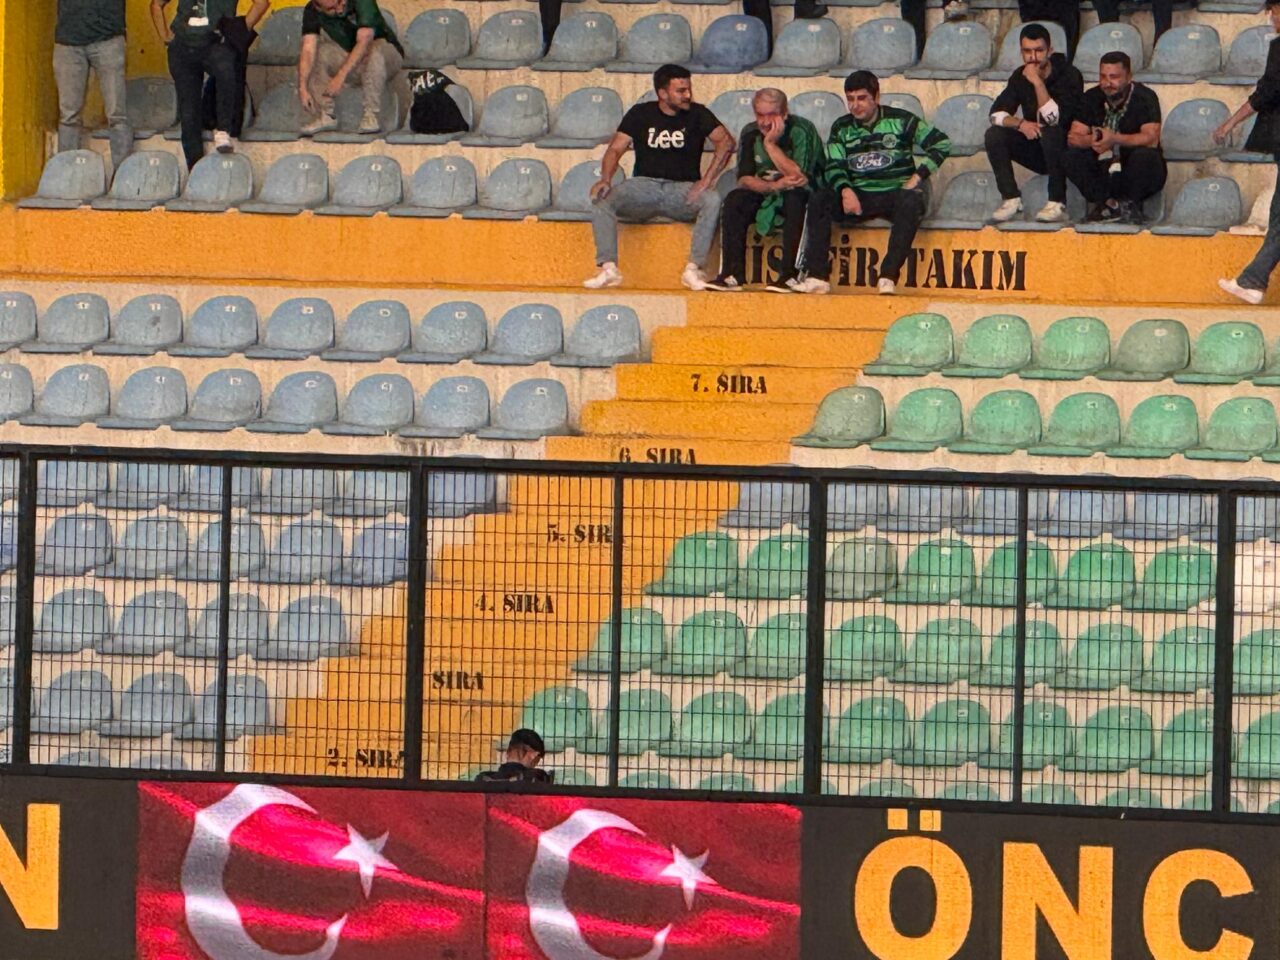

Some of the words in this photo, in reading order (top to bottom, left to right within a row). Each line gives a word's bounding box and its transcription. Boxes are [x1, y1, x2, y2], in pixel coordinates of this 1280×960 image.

[647, 126, 686, 149] Lee
[902, 248, 1028, 291] TAKIM
[690, 373, 709, 393] 7.
[716, 374, 768, 394] SIRA
[646, 447, 697, 465] SIRA
[503, 593, 554, 614] SIRA
[432, 670, 484, 691] SIRA
